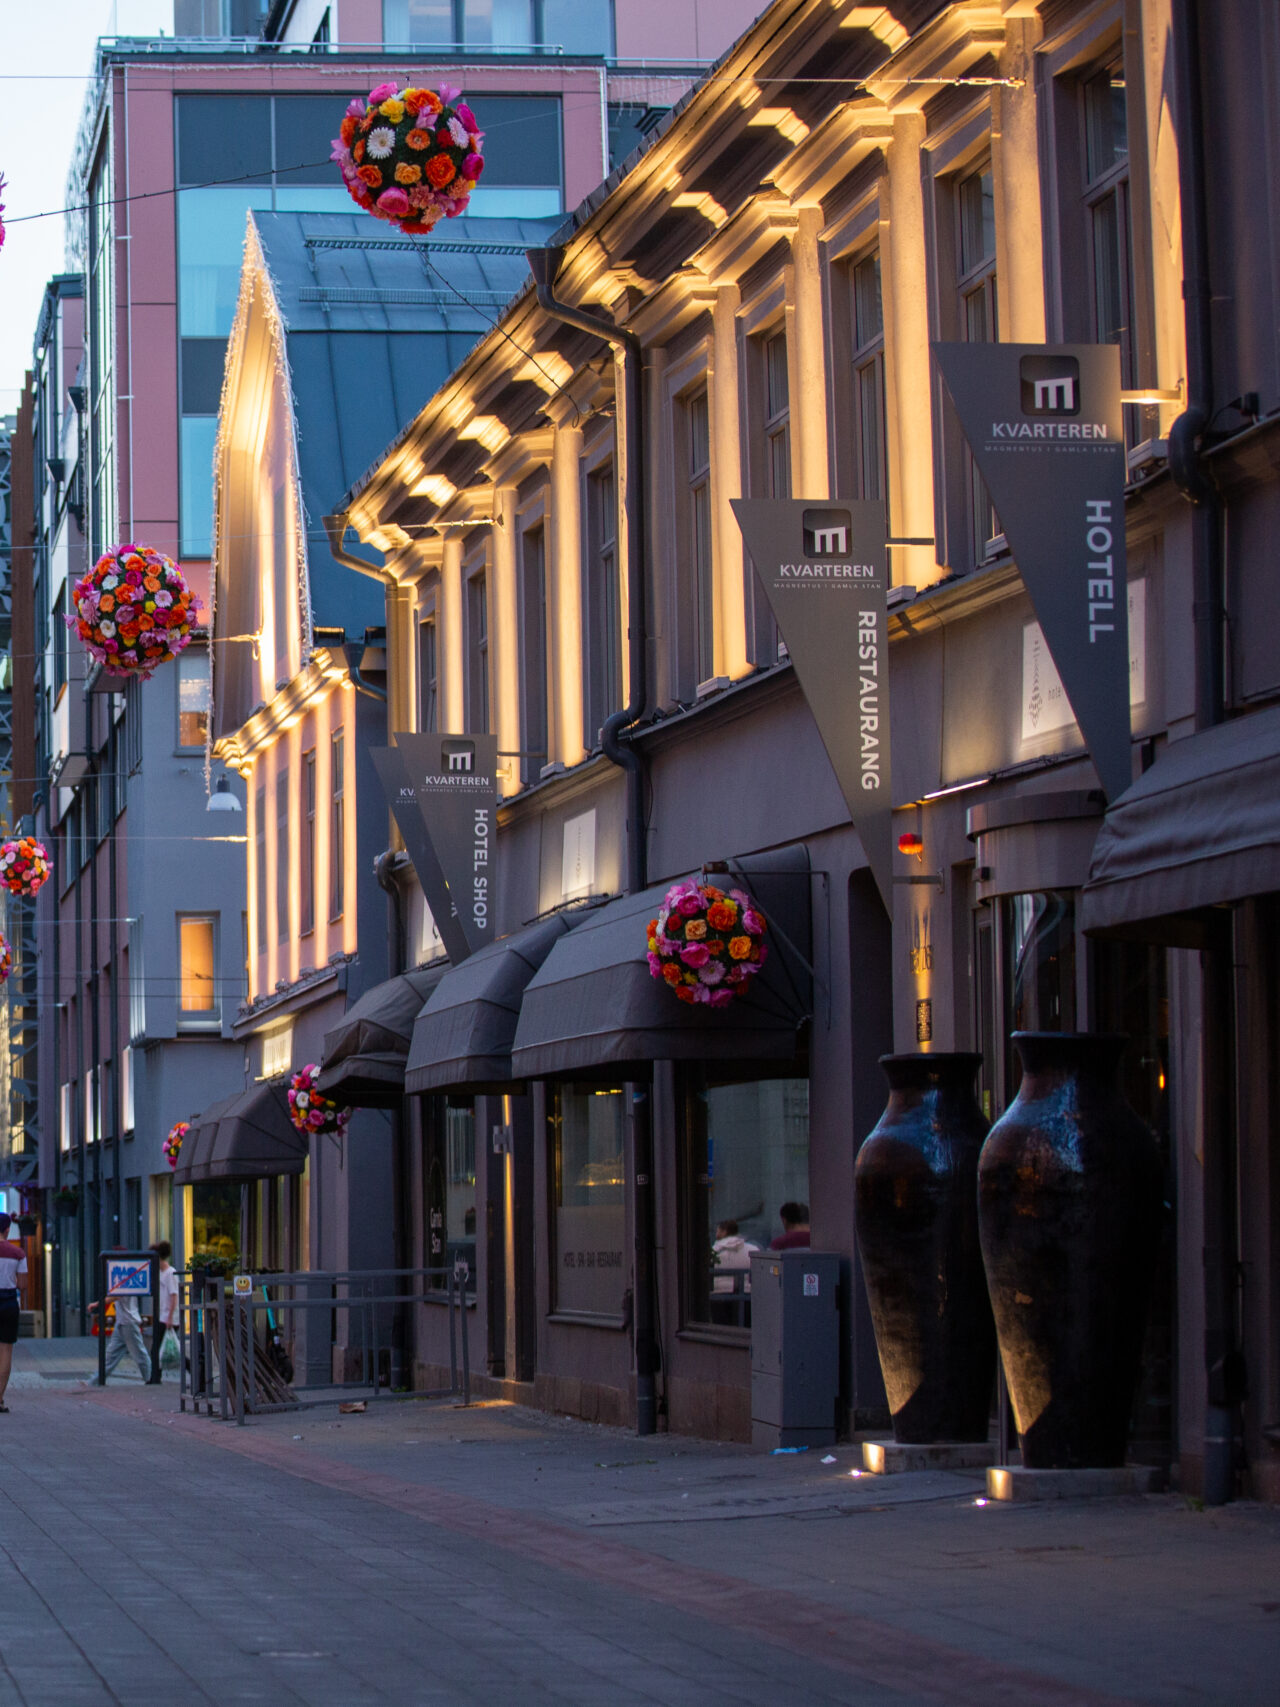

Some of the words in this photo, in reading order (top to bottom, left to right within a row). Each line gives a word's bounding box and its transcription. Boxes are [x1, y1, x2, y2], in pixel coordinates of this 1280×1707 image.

[992, 423, 1107, 438] KVARTEREN
[780, 564, 874, 577] KVARTEREN
[1086, 500, 1114, 643] HOTELL
[858, 611, 880, 790] RESTAURANG
[425, 776, 489, 785] KVARTEREN
[474, 809, 488, 871] HOTEL
[473, 878, 487, 929] SHOP
